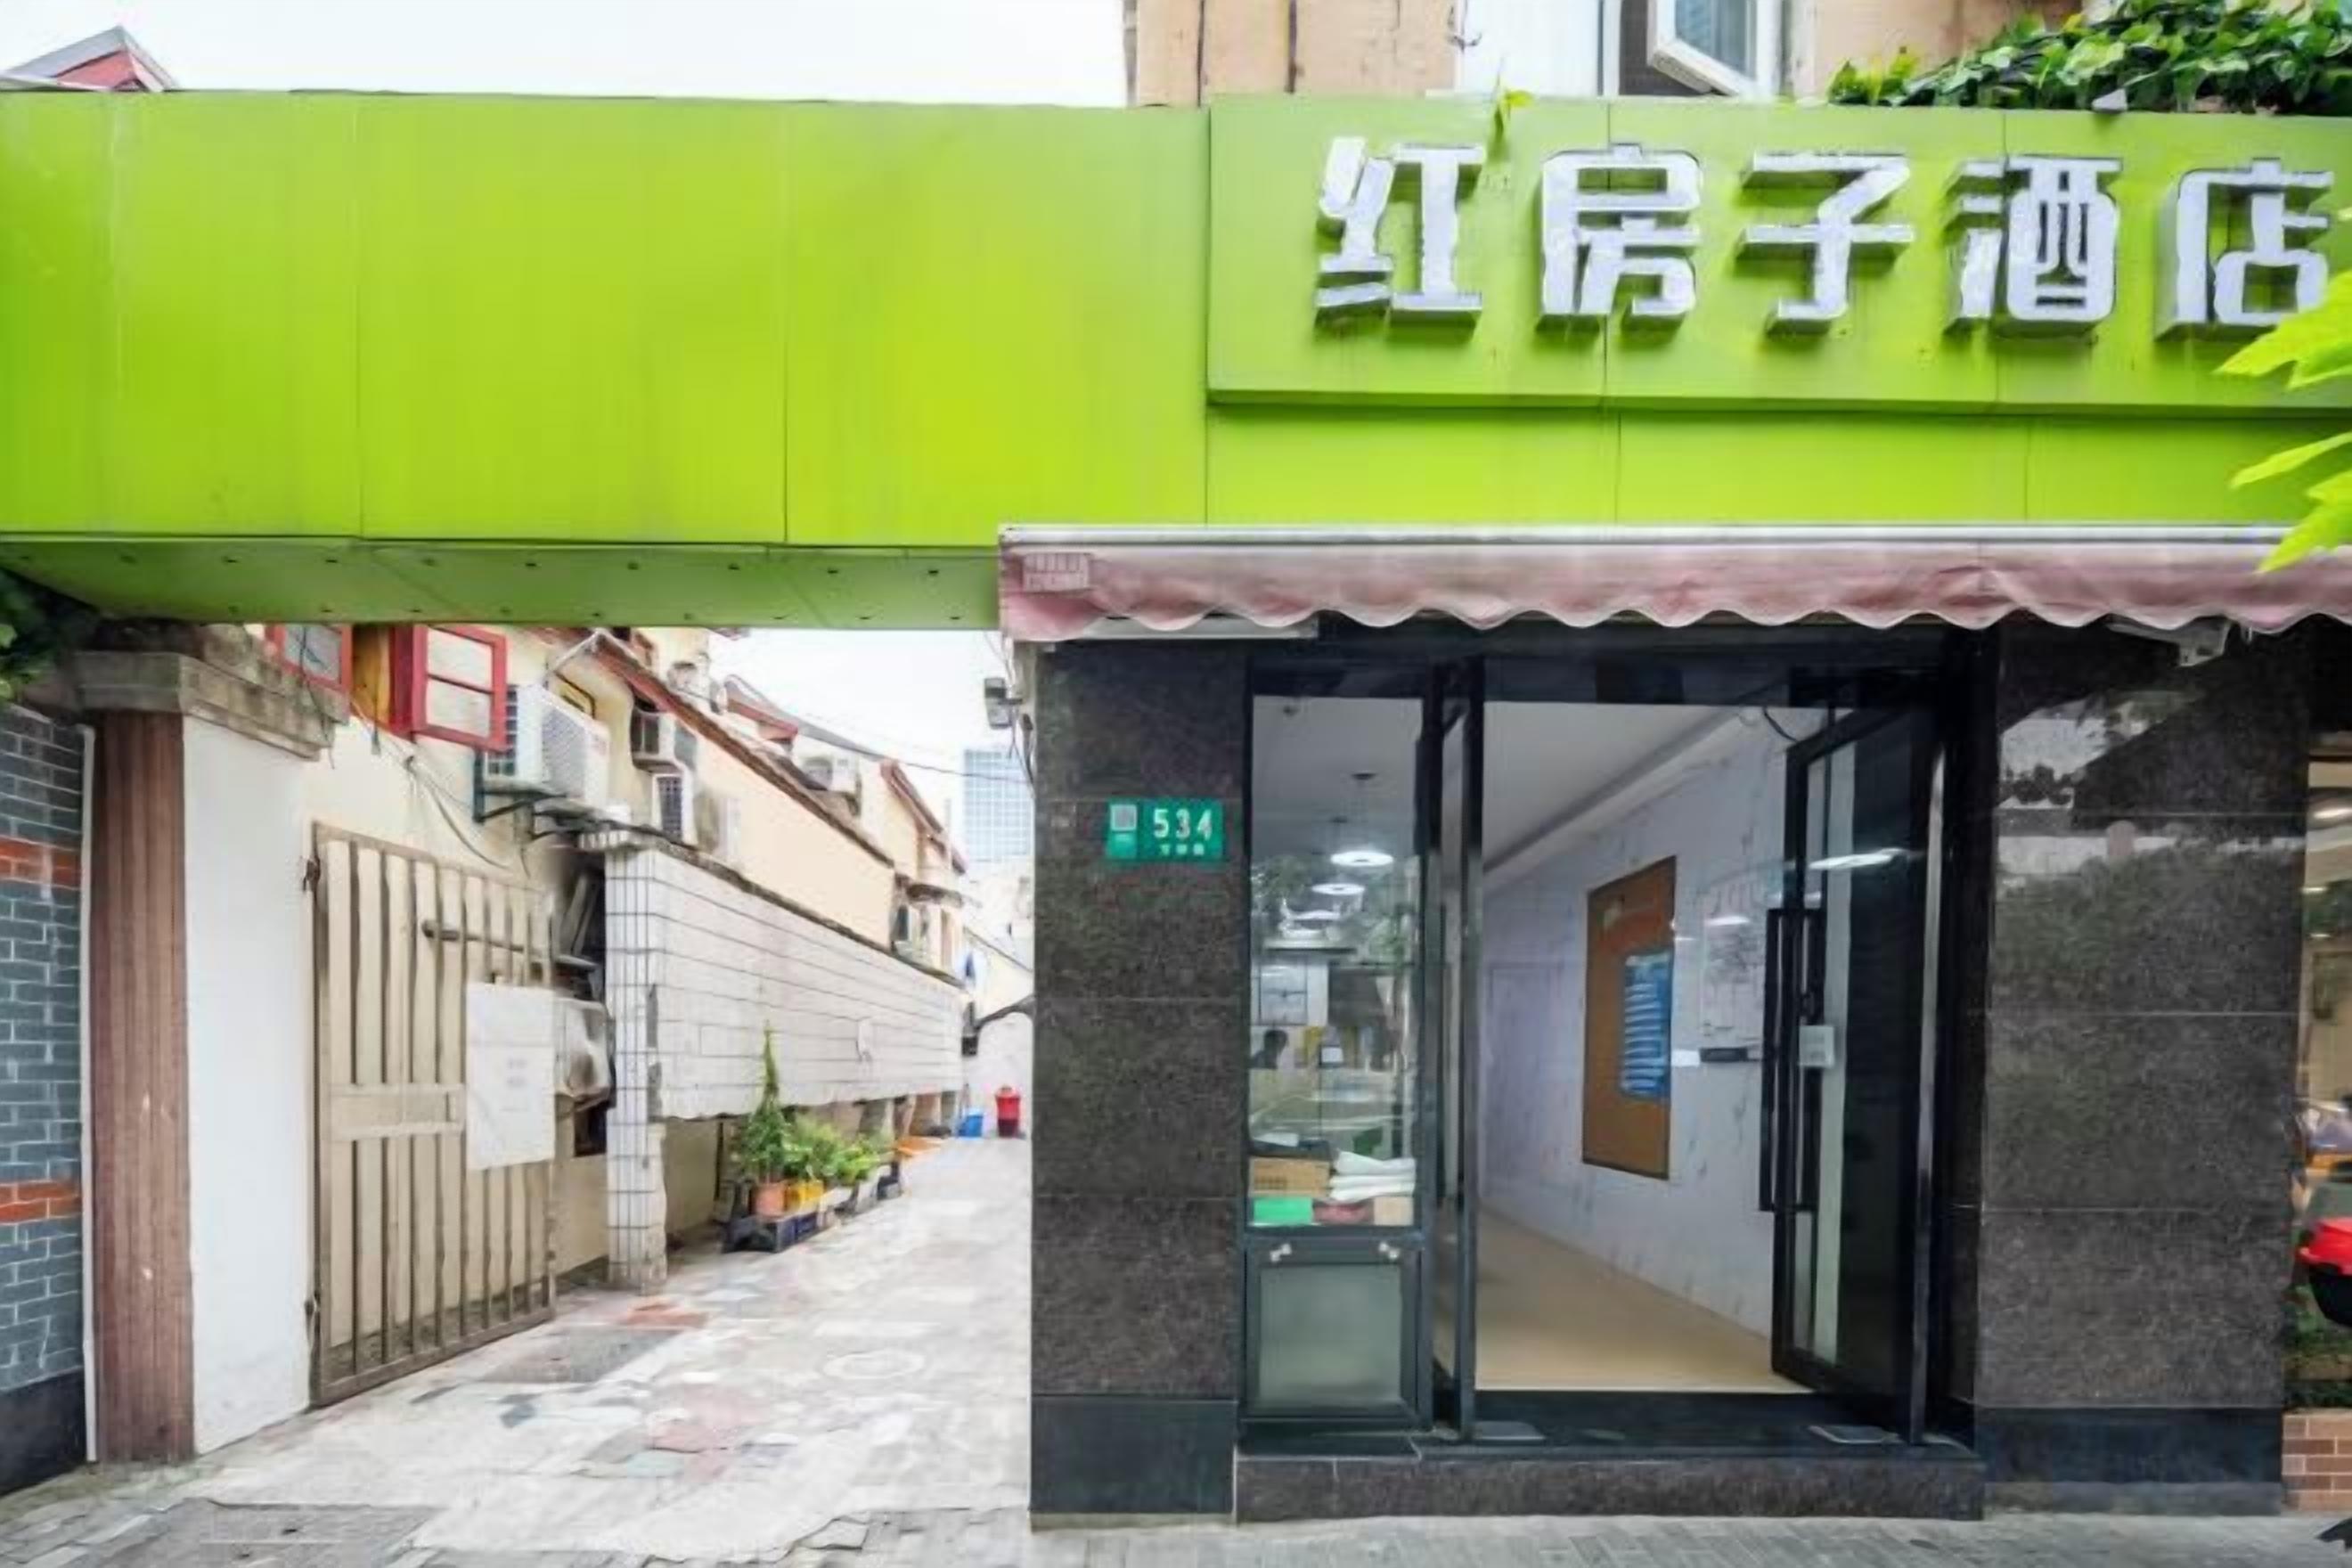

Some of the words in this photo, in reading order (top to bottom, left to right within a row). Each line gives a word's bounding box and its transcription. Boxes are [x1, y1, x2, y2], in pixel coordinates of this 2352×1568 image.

[1316, 136, 2332, 326] 红房子酒店
[1154, 807, 1213, 840] 534
